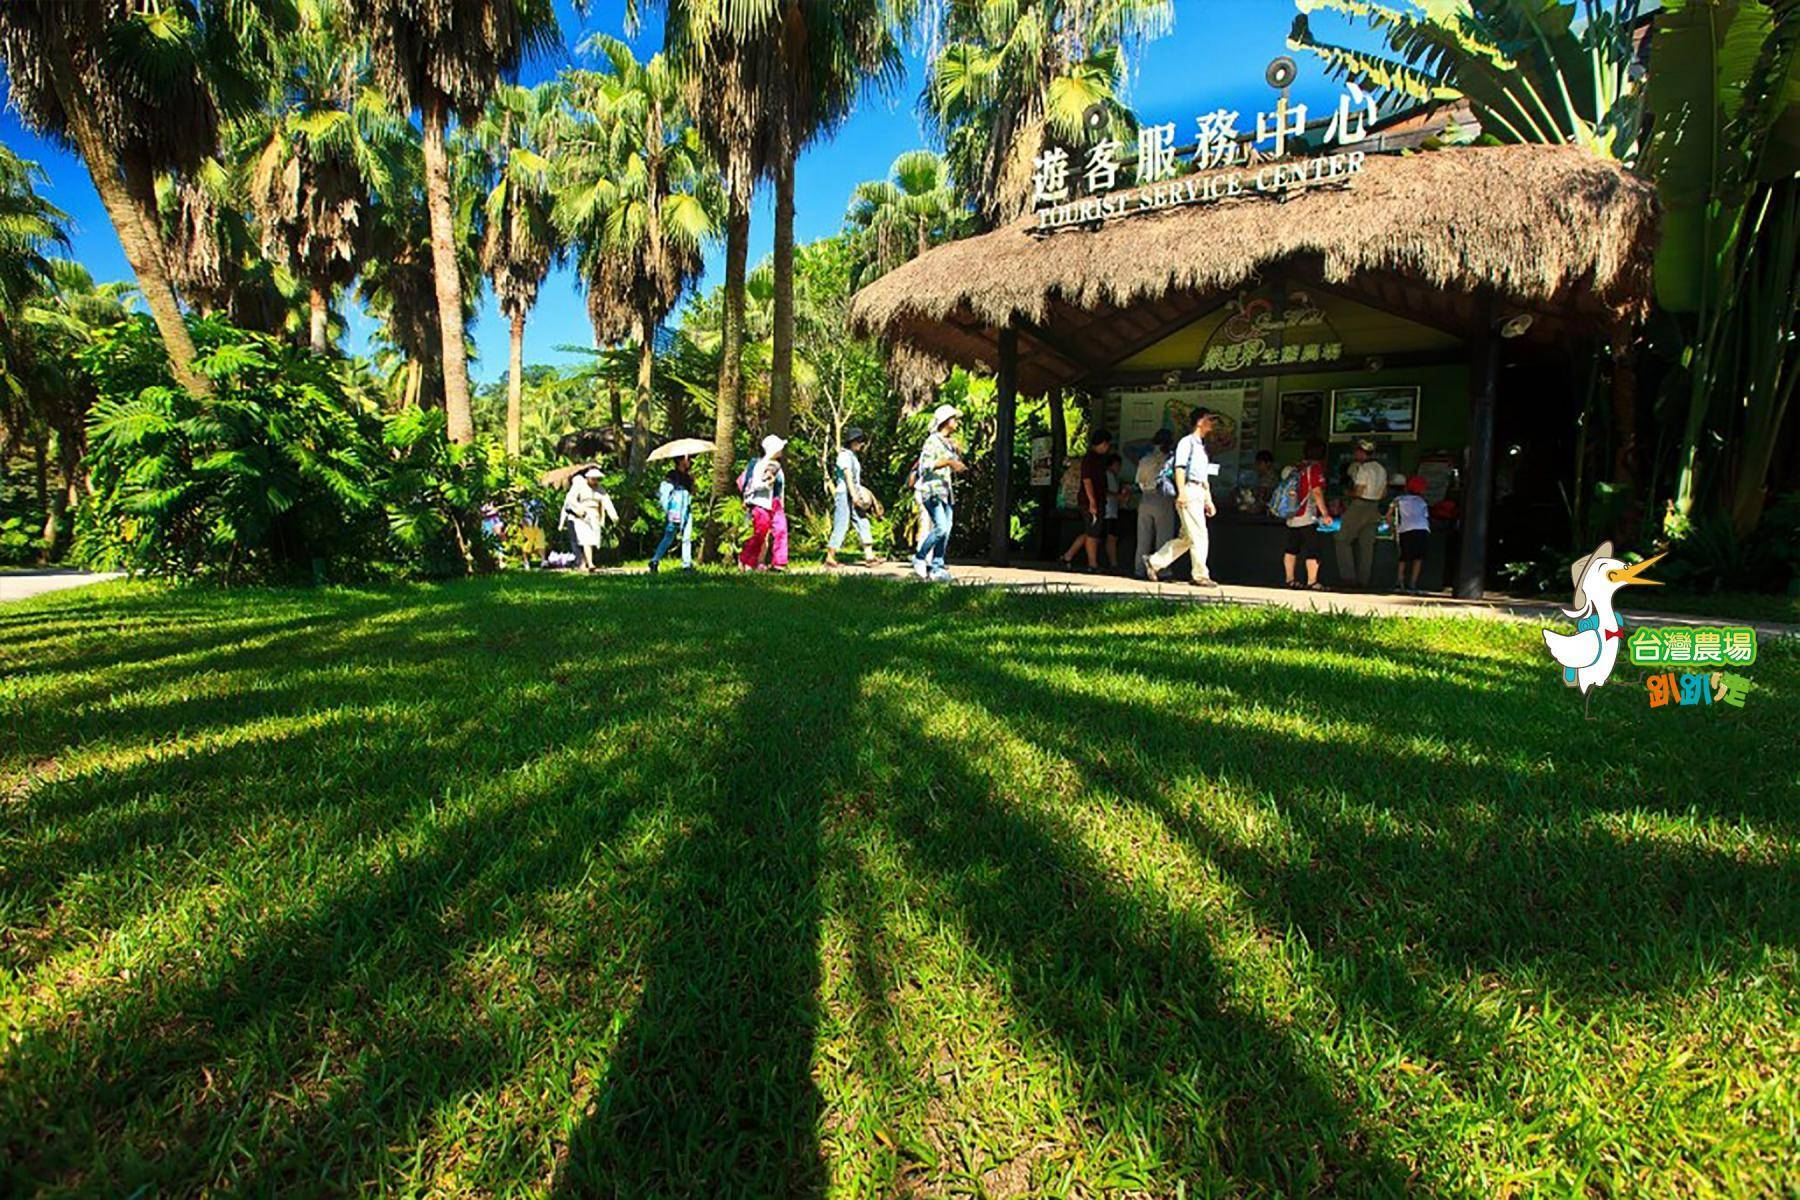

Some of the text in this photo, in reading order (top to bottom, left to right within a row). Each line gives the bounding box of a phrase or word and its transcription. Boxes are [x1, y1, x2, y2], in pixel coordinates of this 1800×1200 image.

[1032, 82, 1378, 211] 遊客服務中心
[1038, 150, 1366, 229] TOURIST SERVICE CENTER
